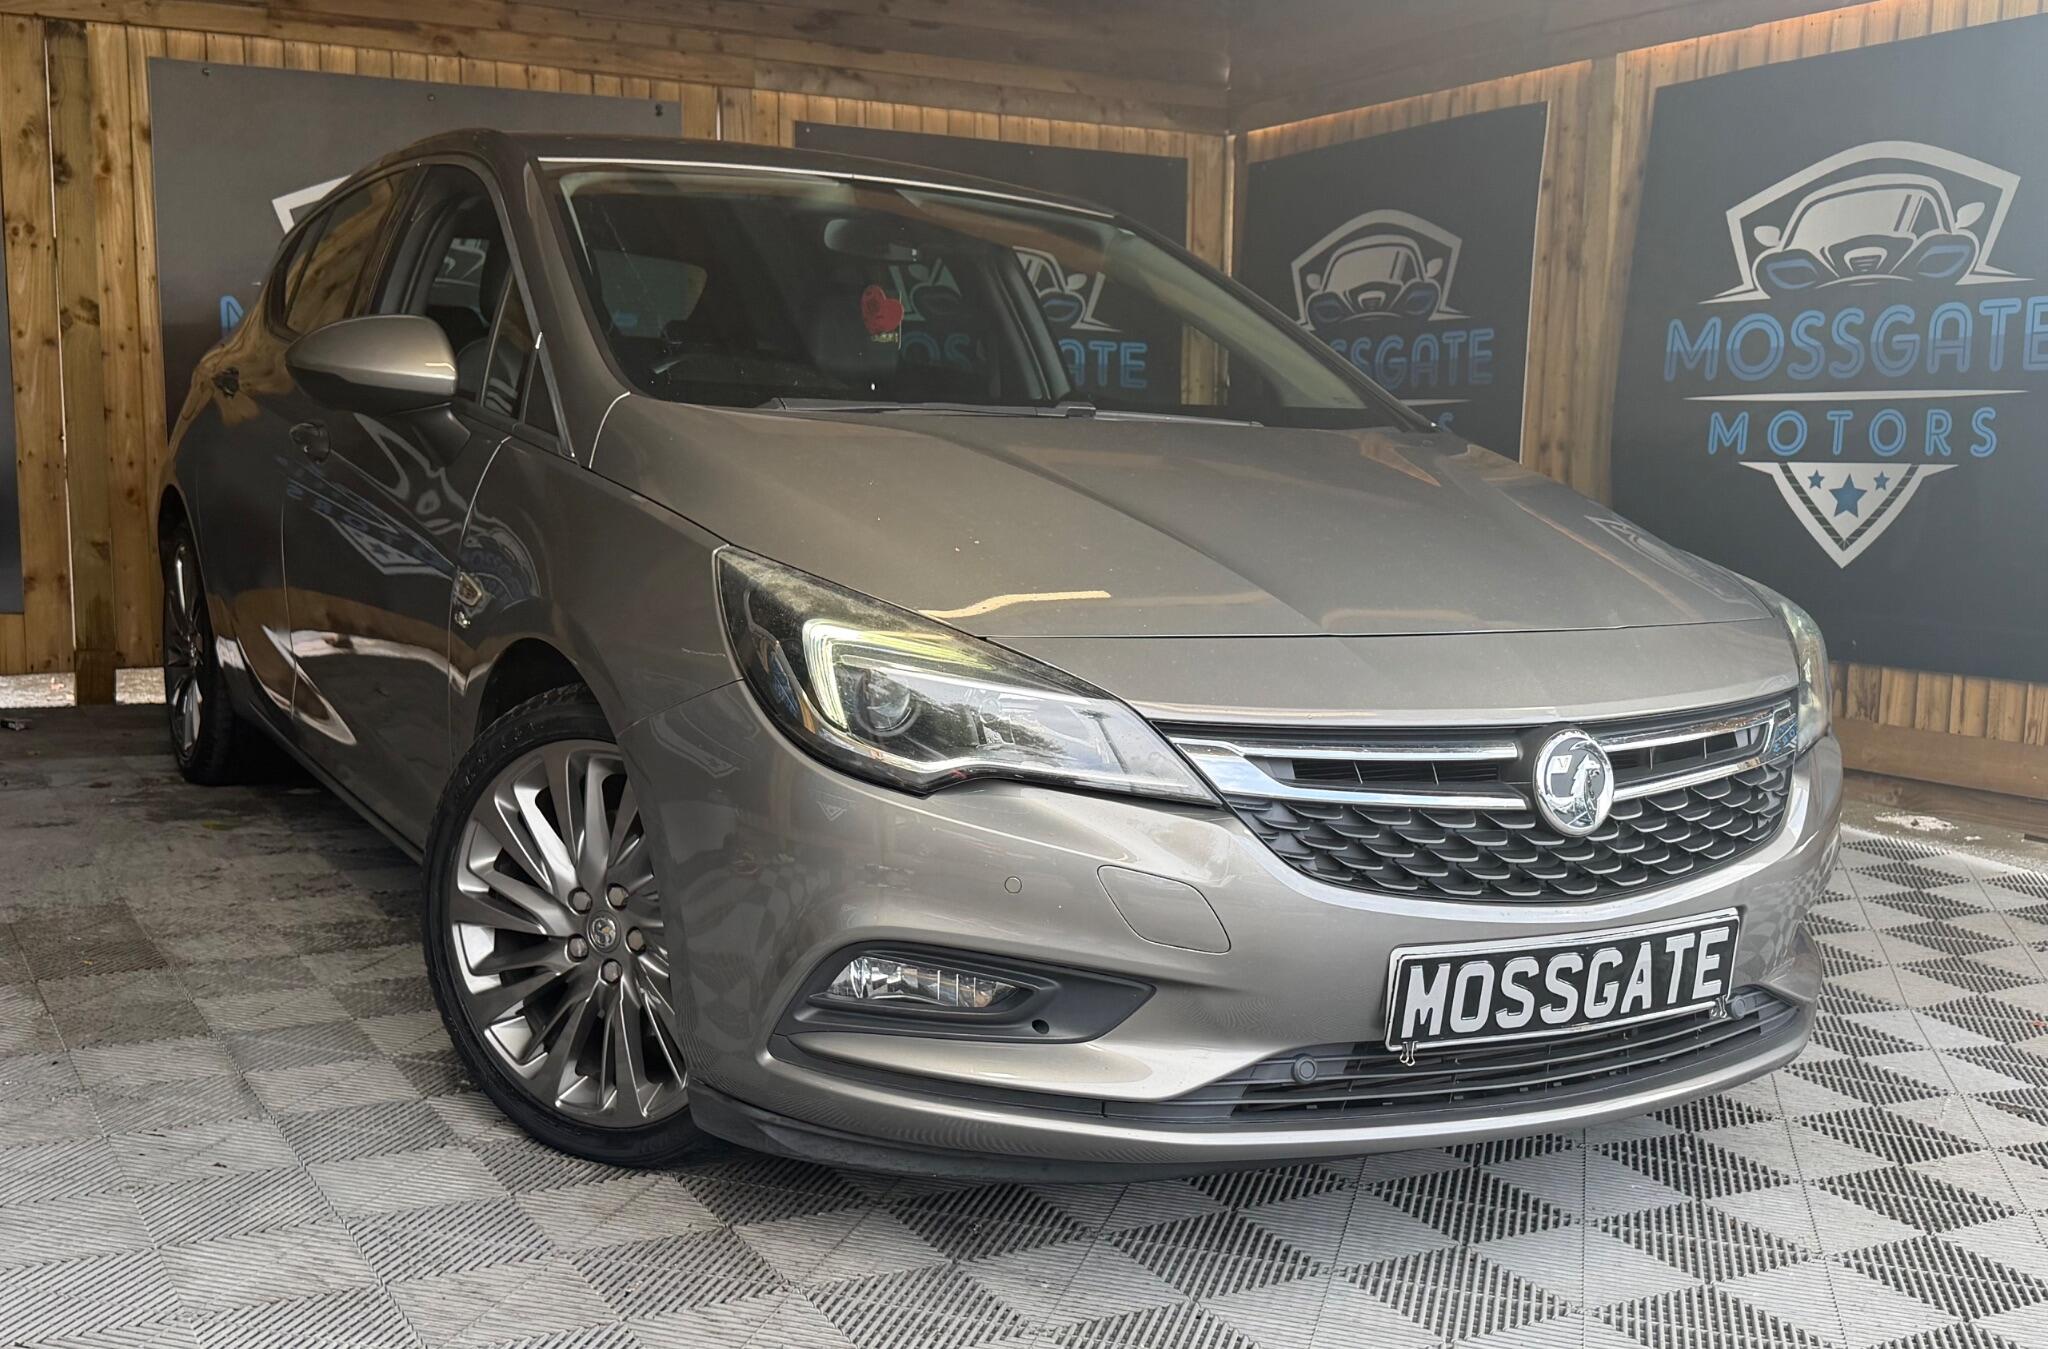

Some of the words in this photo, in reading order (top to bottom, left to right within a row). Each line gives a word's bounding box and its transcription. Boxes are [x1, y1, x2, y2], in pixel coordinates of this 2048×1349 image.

[1664, 296, 2048, 381] MOSSGATE
[1707, 407, 1998, 458] MOTORS
[1400, 926, 1730, 1039] MOSSGATE
